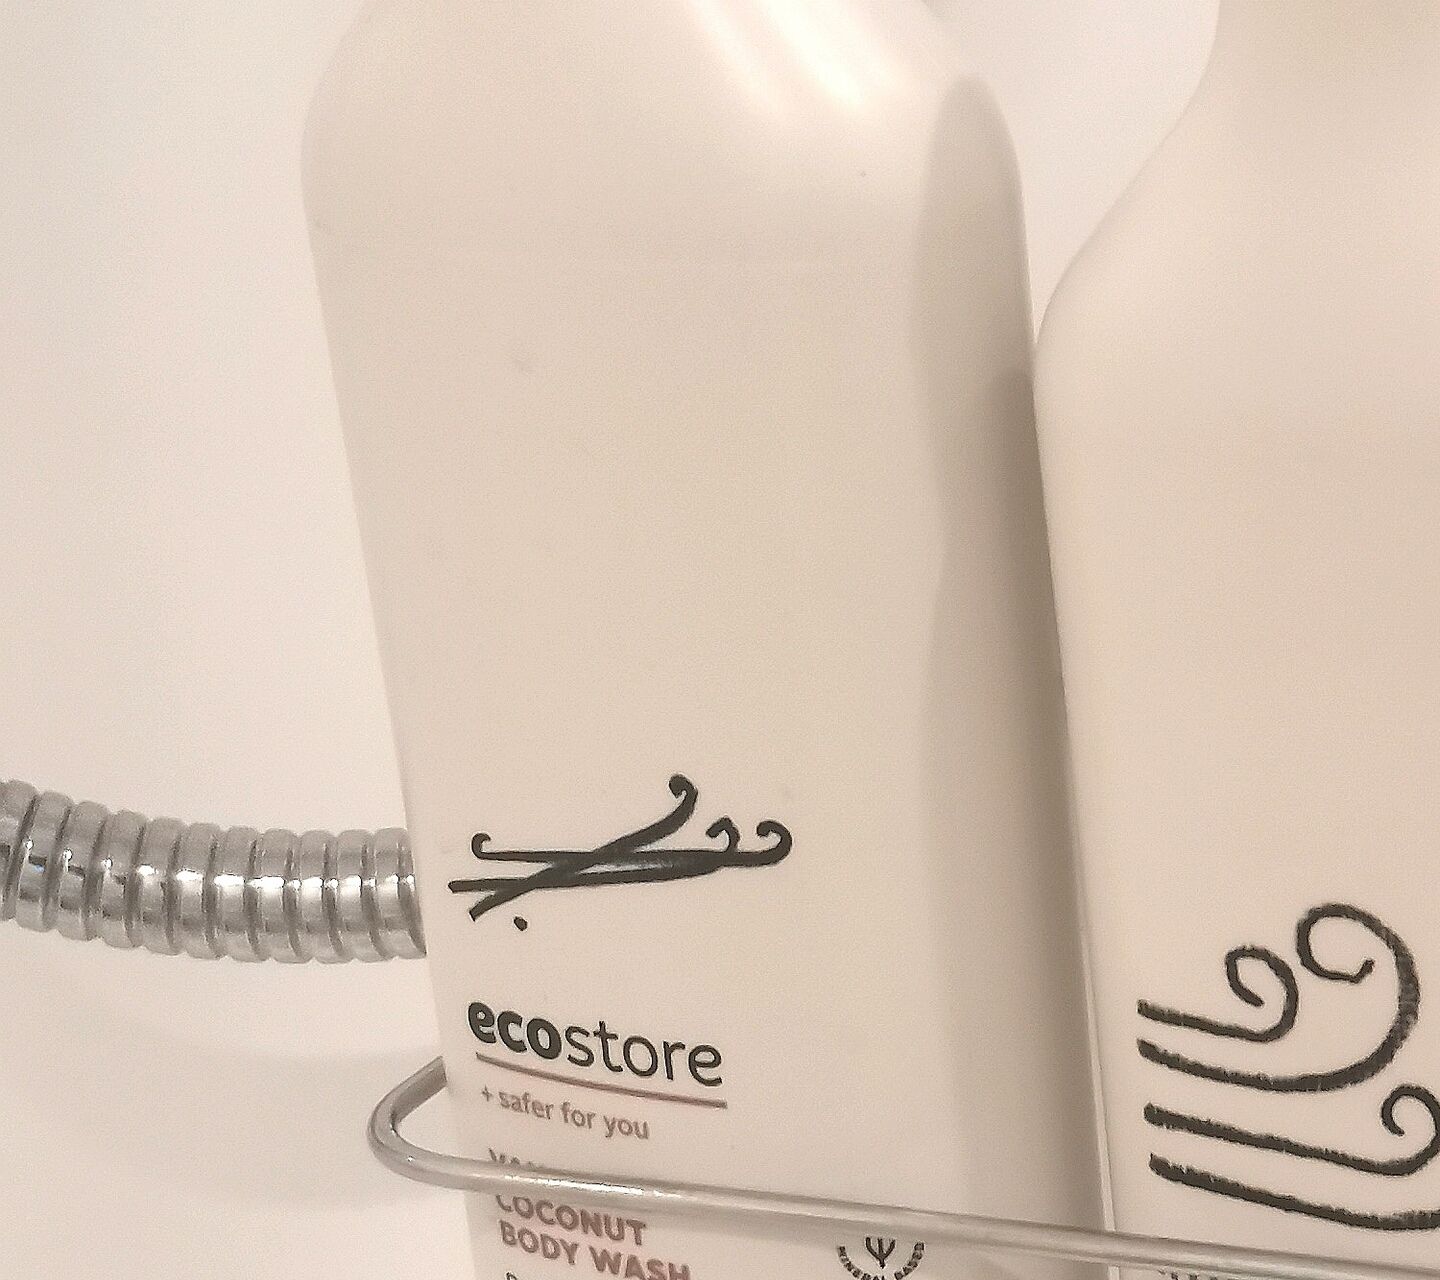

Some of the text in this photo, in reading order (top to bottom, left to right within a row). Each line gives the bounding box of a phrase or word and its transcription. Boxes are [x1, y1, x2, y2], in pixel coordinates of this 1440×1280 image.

[467, 1001, 723, 1087] ecostore
[498, 1090, 554, 1120] safer
[560, 1101, 596, 1130] for
[603, 1113, 650, 1140] you
[499, 1219, 579, 1266] BODY
